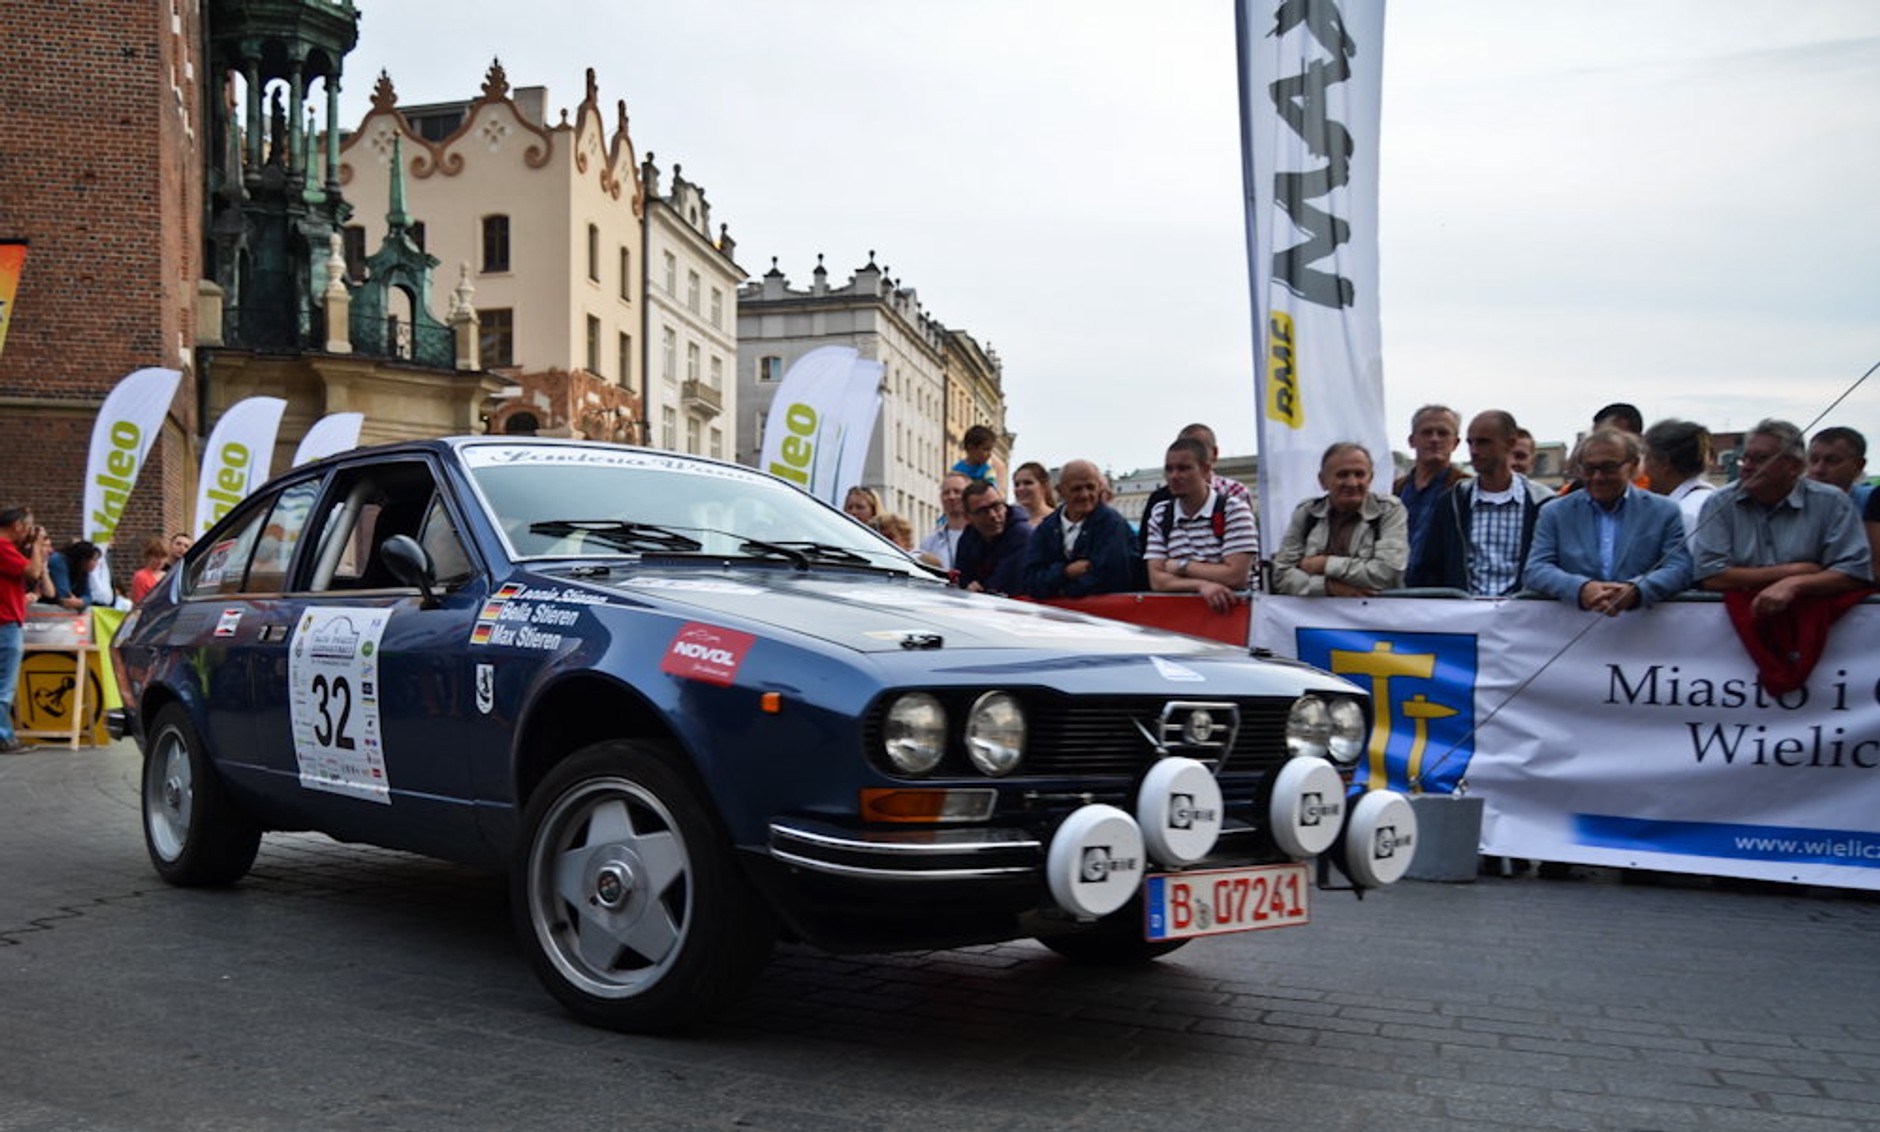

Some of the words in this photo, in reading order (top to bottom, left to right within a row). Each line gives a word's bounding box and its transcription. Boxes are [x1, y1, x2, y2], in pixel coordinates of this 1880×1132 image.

[203, 442, 249, 531] aleo
[531, 603, 579, 626] Stieren
[490, 624, 516, 646] Max
[516, 626, 561, 650] Stieren
[673, 641, 735, 667] NOVOL
[312, 674, 356, 750] 32
[1831, 669, 1849, 711] i
[1685, 722, 1880, 768] Wielic
[1171, 883, 1193, 930] B
[1213, 873, 1304, 924] 07241
